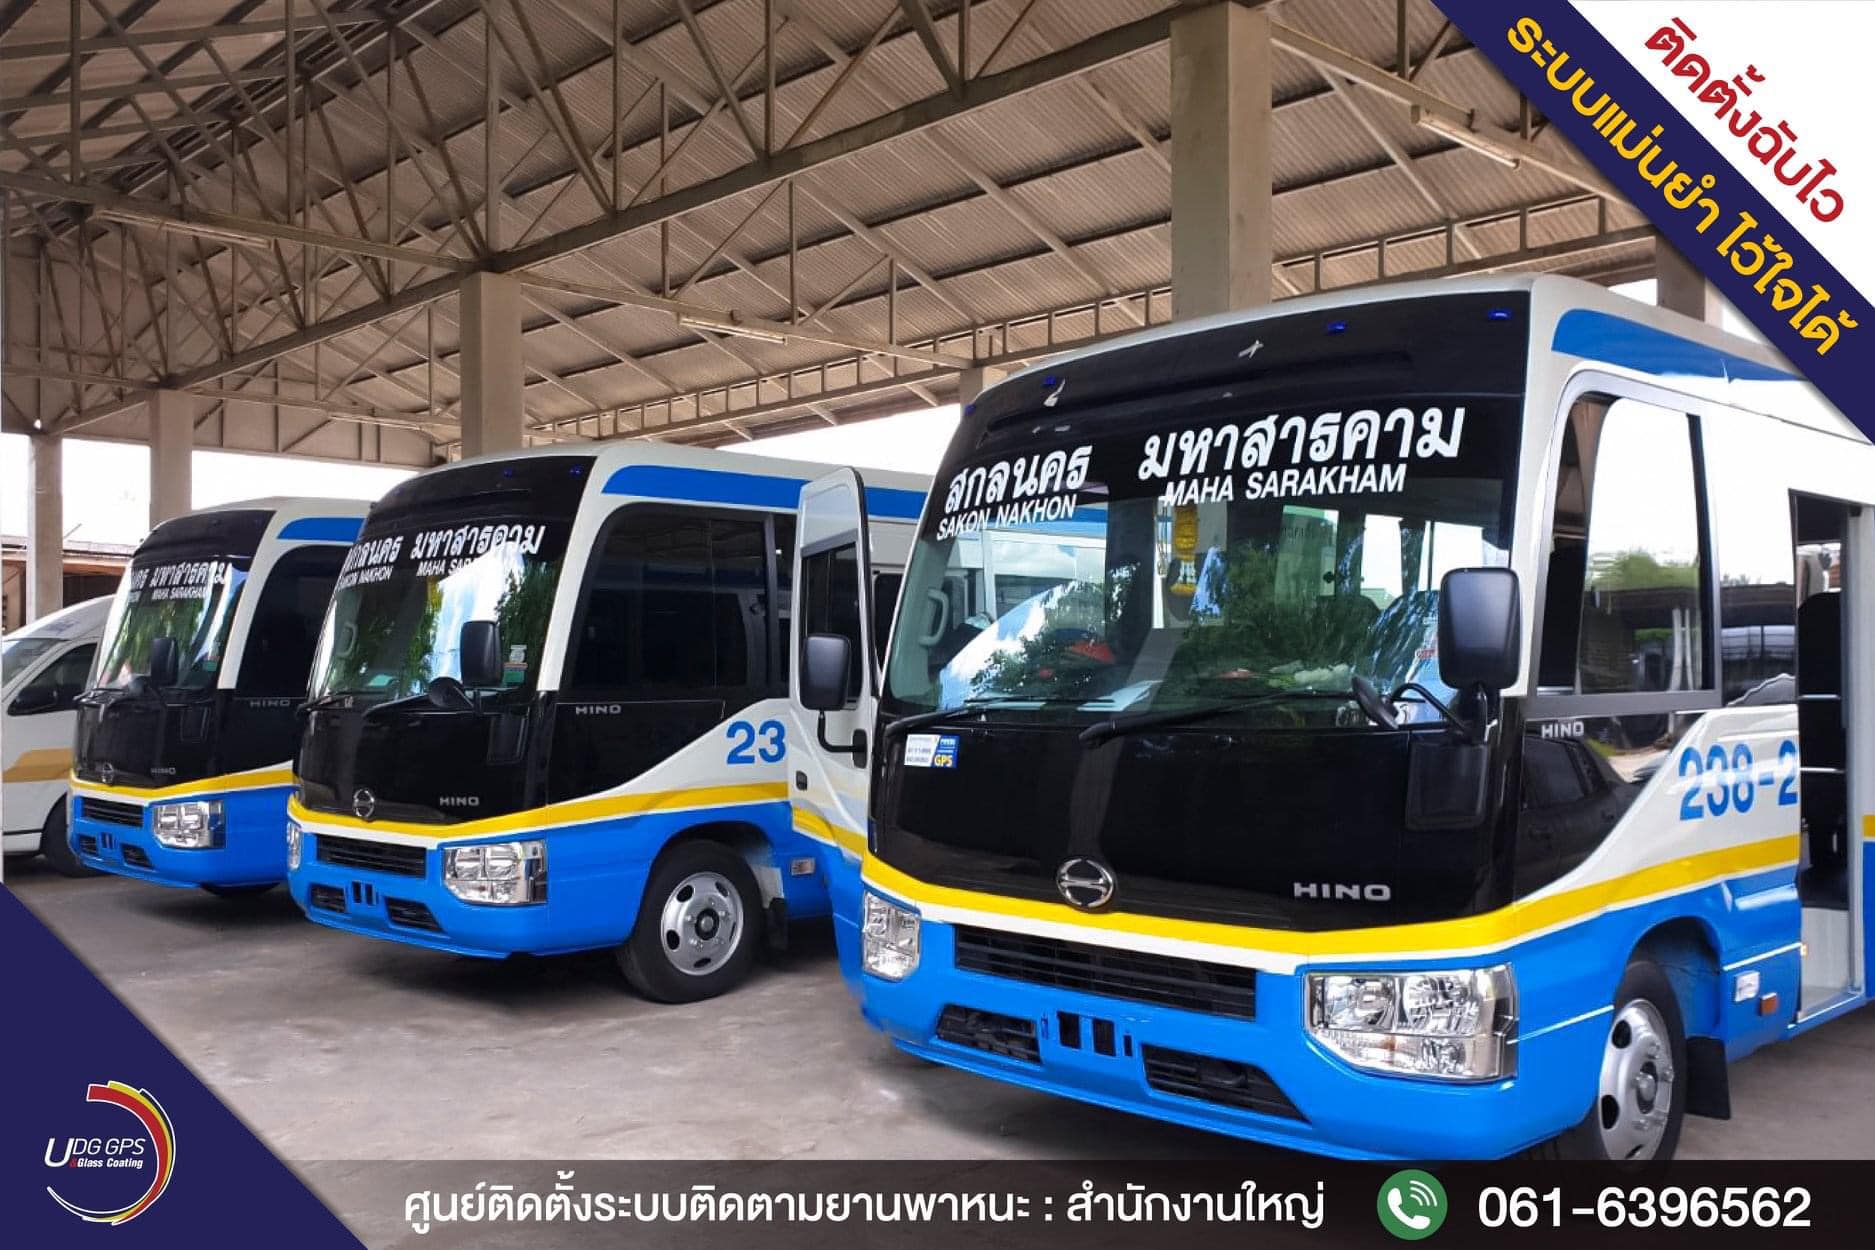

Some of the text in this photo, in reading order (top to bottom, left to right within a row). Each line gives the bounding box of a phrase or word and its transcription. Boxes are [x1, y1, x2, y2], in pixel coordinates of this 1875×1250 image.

[1138, 407, 1466, 481] มหาสารคาม
[944, 445, 1093, 515] สกลนคร
[1162, 463, 1407, 508] MAHA SARAKHAM
[936, 494, 1077, 541] SAKON NAKHON
[416, 559, 446, 577] MAHA
[575, 704, 622, 715] HINO
[726, 719, 786, 764] 23
[1541, 721, 1584, 739] HINO
[439, 796, 480, 807] HINO
[1293, 882, 1391, 901] HINO
